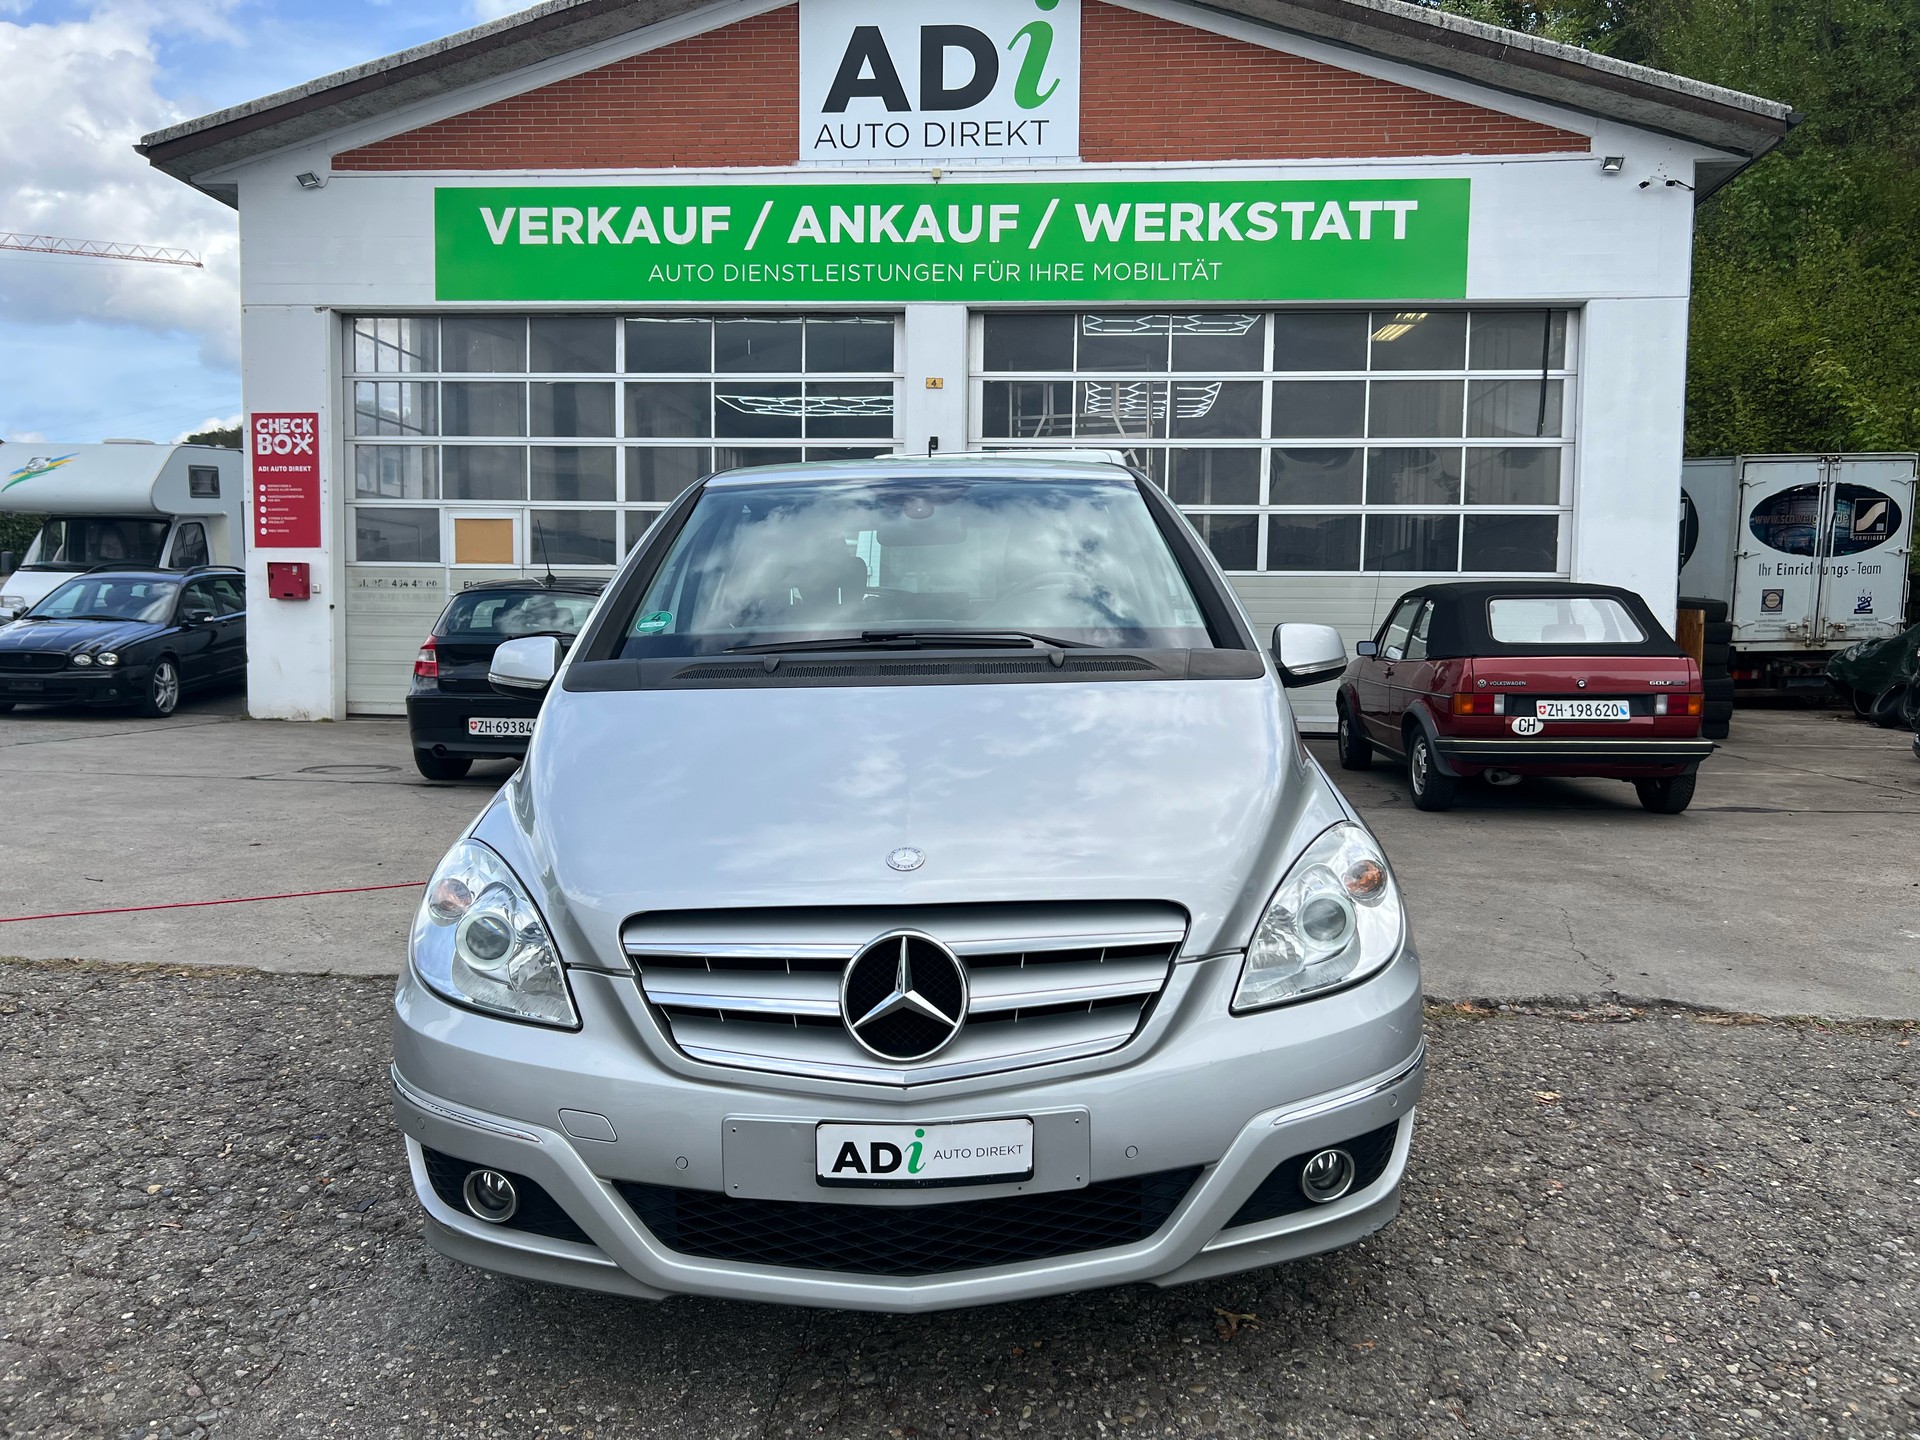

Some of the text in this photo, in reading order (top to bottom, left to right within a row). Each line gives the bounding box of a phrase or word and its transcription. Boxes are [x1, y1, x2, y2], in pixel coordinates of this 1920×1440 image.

[814, 120, 1049, 149] AUTO DIREKT
[479, 198, 1418, 251] VERKAUF / ANKAUF / WERKSTATT
[648, 259, 1222, 282] AUTO DIENSTLEISTUNGEN FÜR IHRE MOBILITÄT
[931, 379, 937, 387] 4
[256, 418, 313, 433] CHECK
[257, 434, 313, 455] BOX
[1758, 563, 1771, 576] Ihr
[1857, 562, 1881, 575] Team
[1518, 718, 1536, 732] CH
[831, 1128, 1024, 1174] ADi AUTO DIREKT
